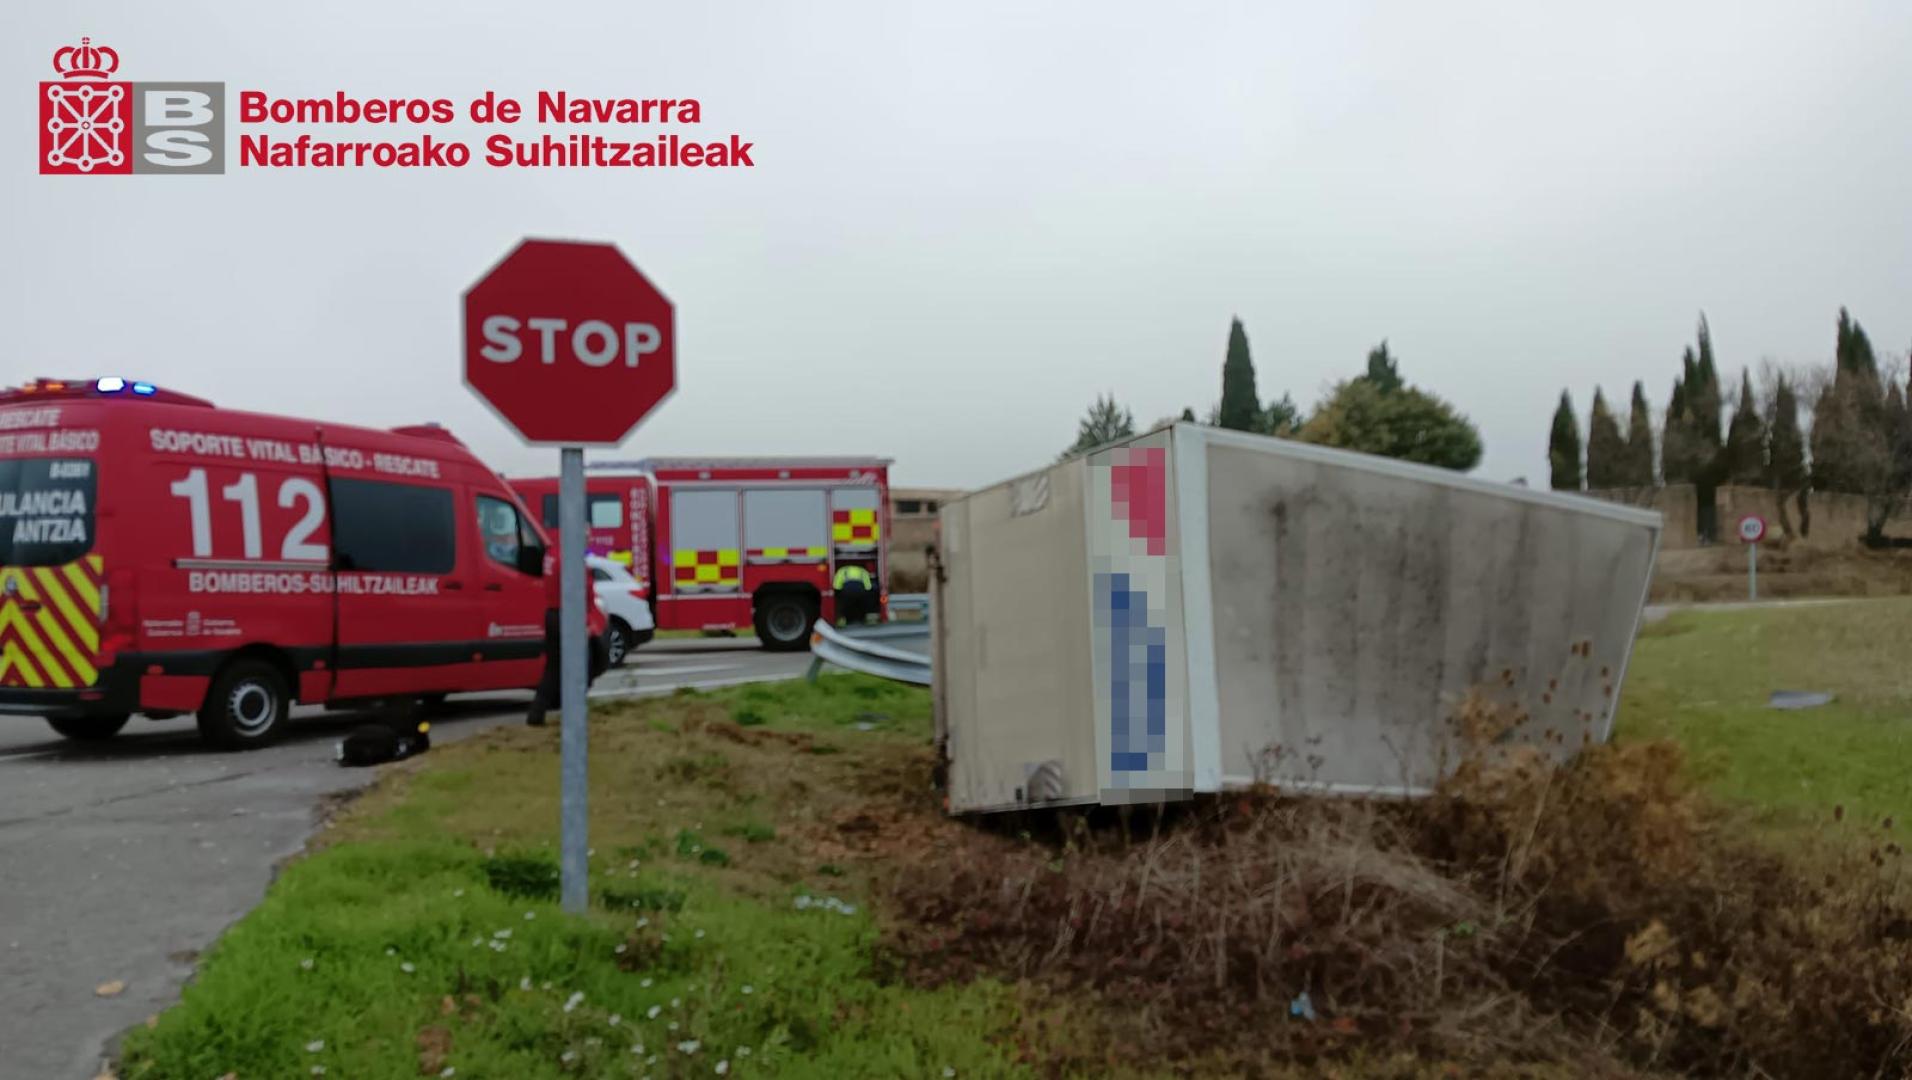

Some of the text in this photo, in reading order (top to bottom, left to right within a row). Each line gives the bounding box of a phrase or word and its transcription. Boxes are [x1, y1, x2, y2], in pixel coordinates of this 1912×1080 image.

[480, 314, 662, 368] STOP
[149, 428, 246, 459] SOPORTE
[246, 438, 298, 465] VITAL
[373, 451, 441, 480] RESCATE
[12, 519, 86, 544] ANTZIA
[170, 468, 331, 561] 112
